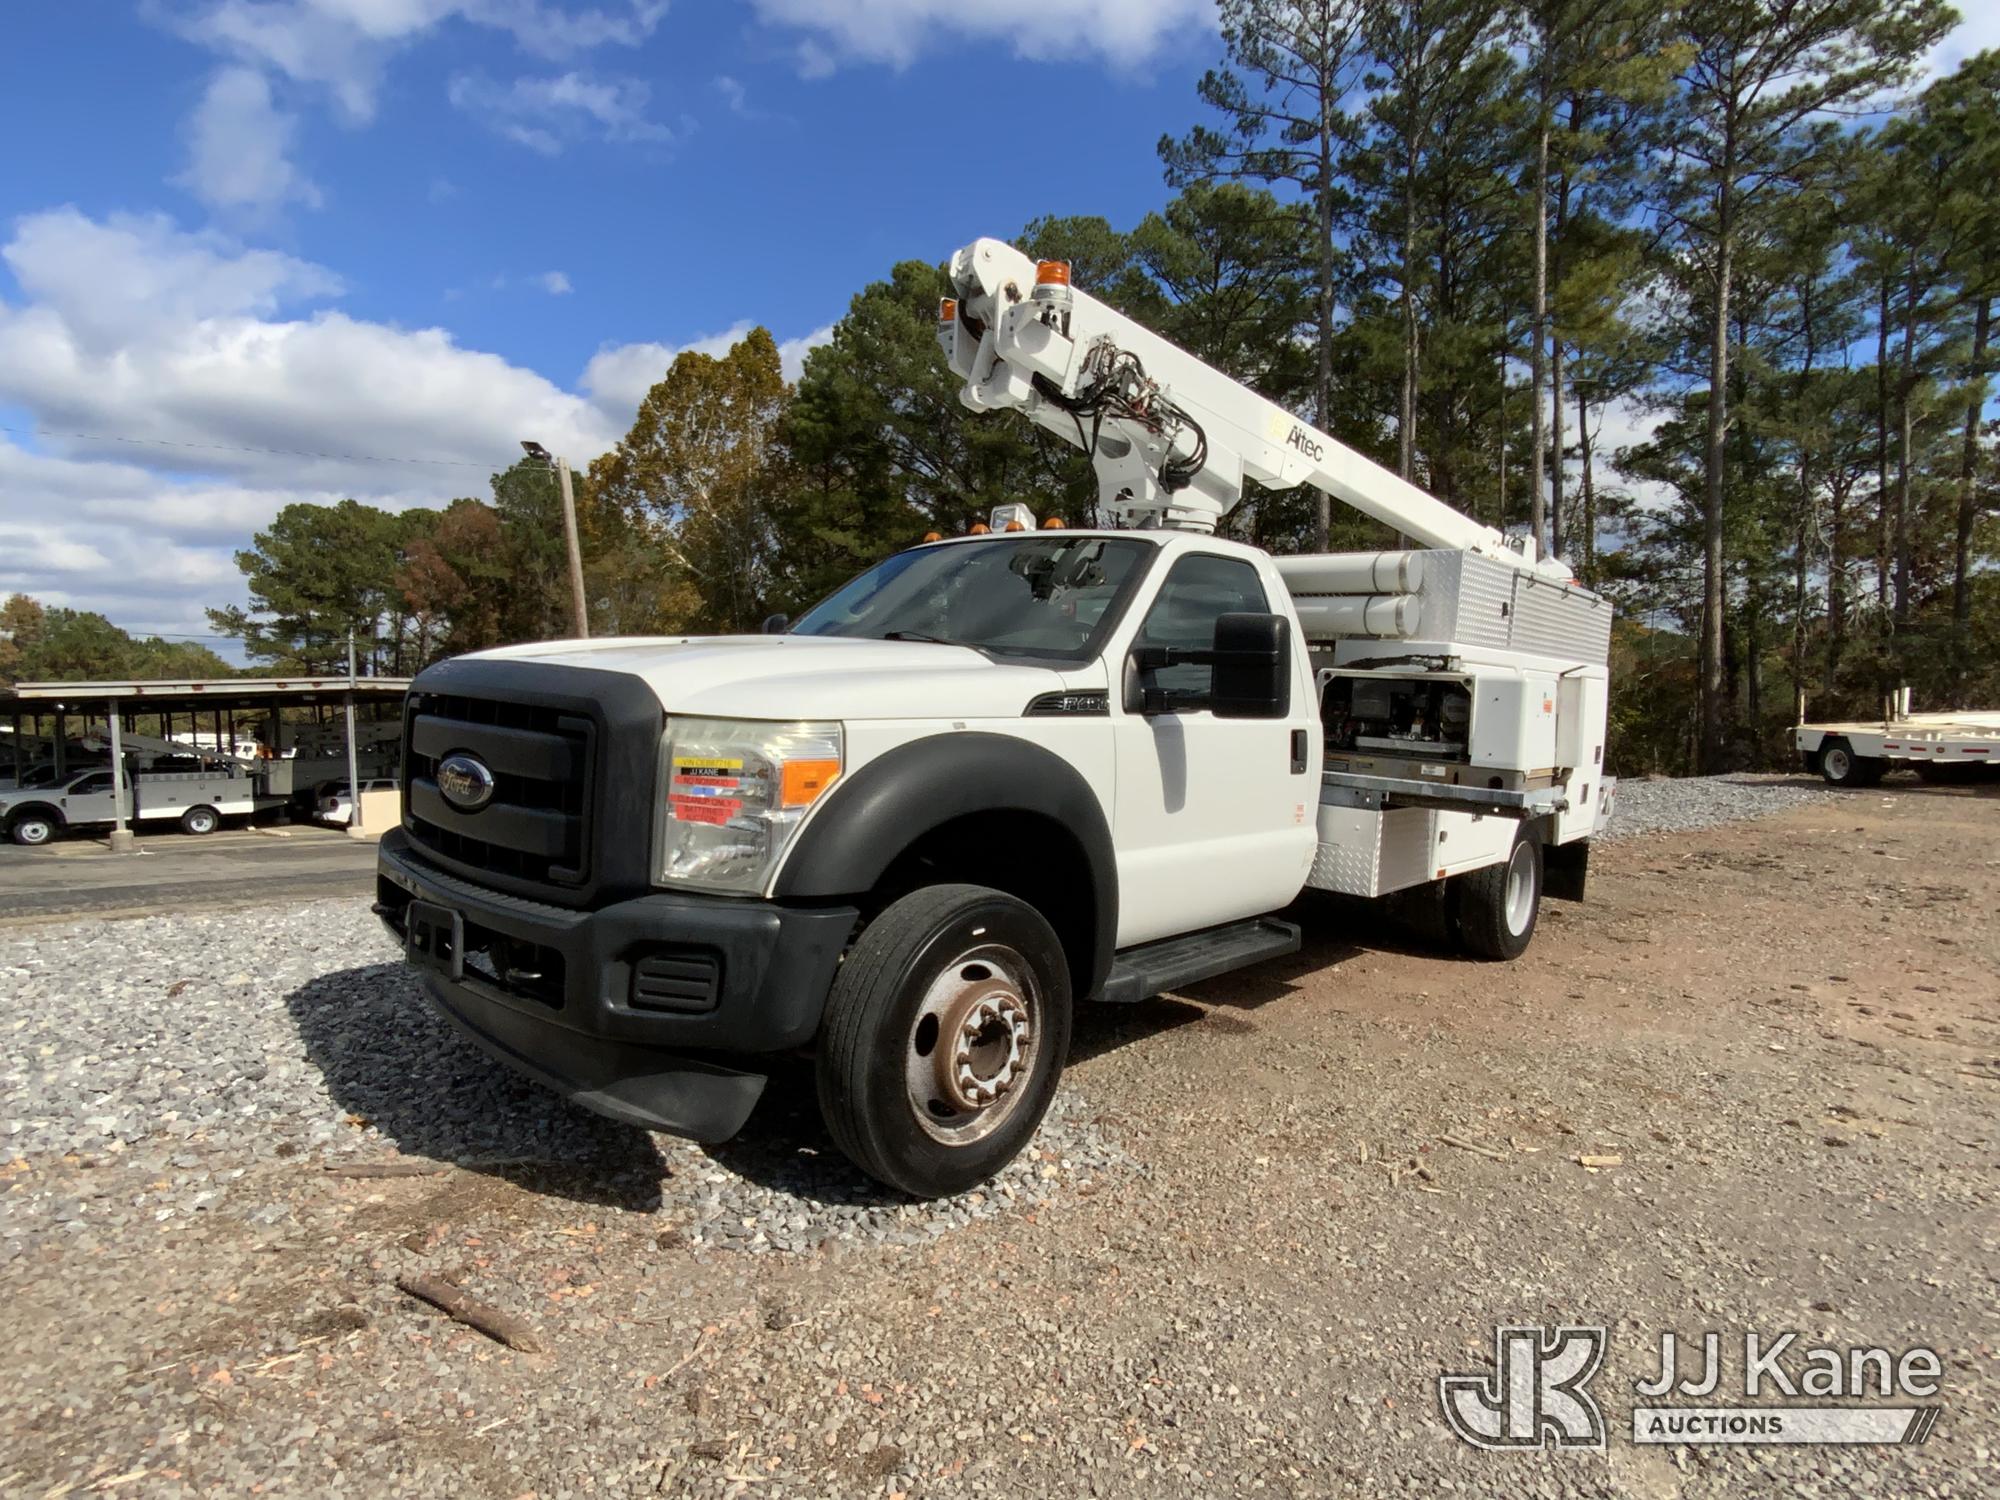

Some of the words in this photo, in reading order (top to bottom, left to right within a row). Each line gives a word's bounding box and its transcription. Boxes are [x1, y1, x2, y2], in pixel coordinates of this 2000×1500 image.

[1286, 425, 1324, 462] Altec
[442, 764, 472, 795] Ford
[698, 768, 719, 776] KANE
[710, 798, 732, 807] ONLY
